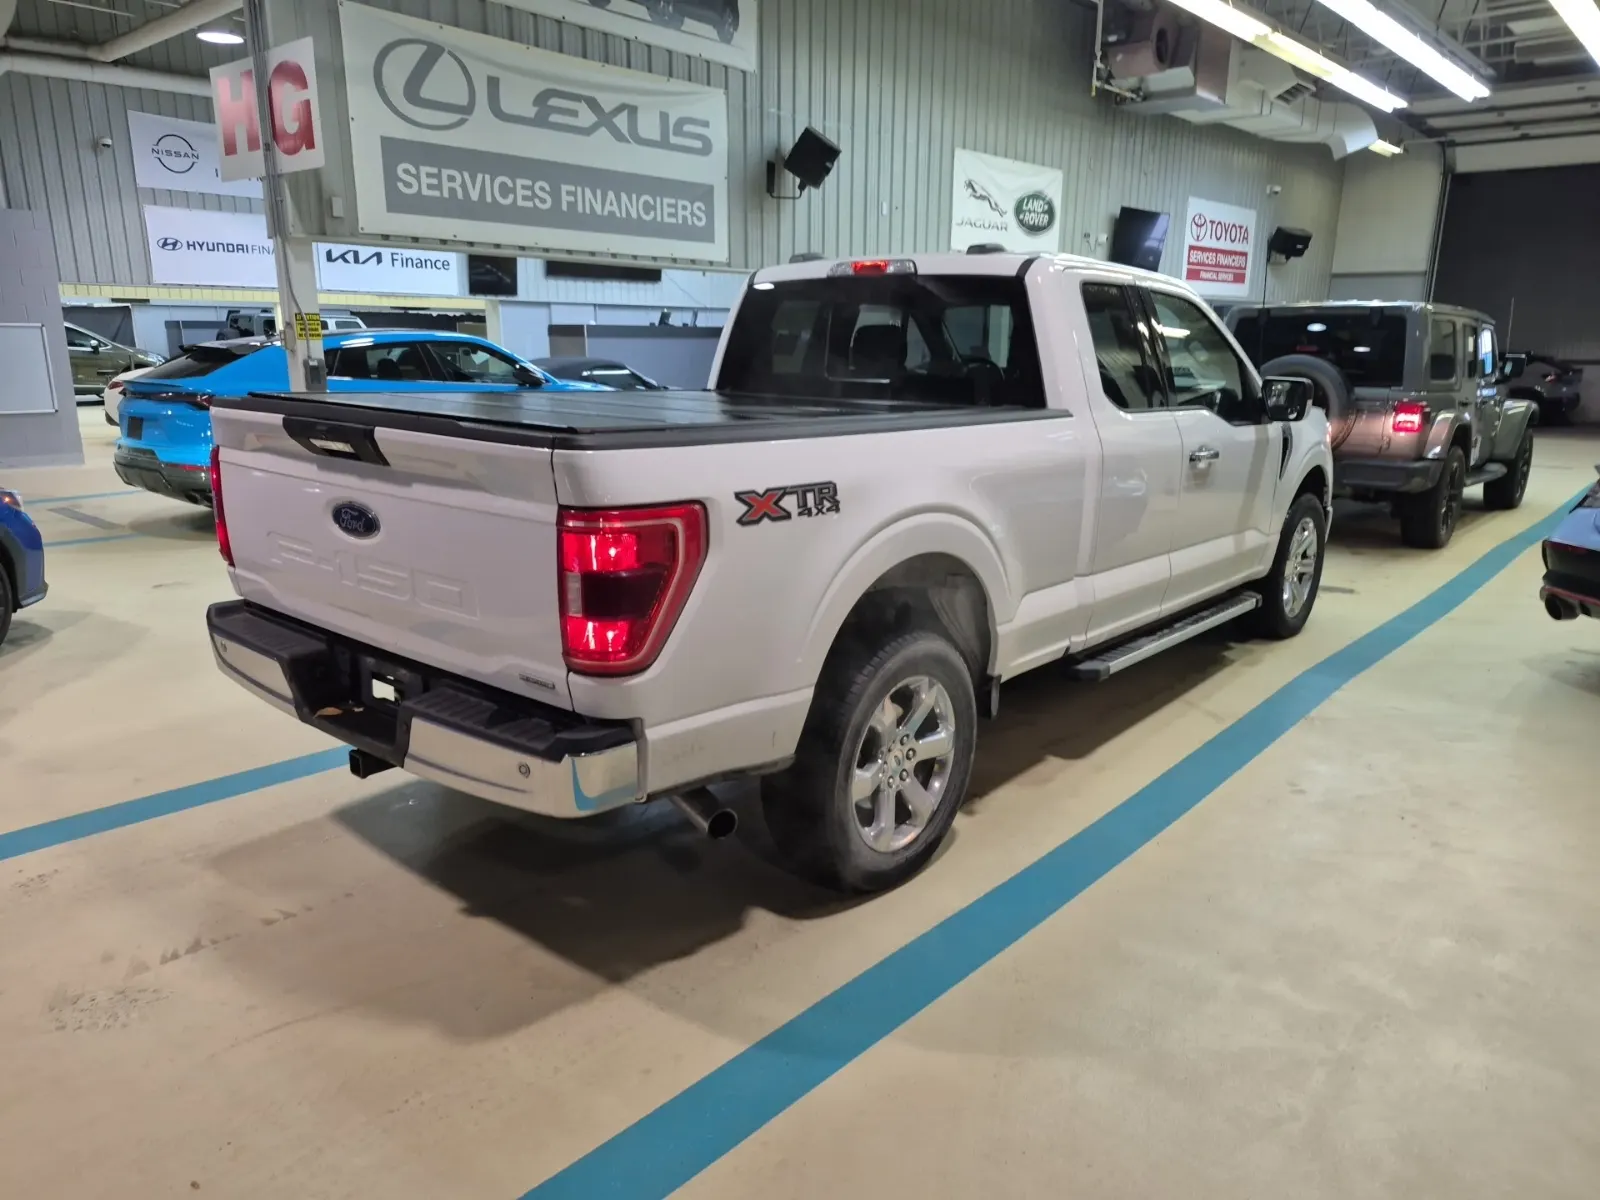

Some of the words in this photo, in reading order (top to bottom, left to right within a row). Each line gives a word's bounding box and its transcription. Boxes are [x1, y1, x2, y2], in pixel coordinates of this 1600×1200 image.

[216, 60, 316, 156] HG
[486, 75, 713, 156] LEXUS
[151, 147, 200, 160] NISSAN
[396, 163, 552, 211] SERVICES
[561, 184, 707, 228] FINANCIERS
[1022, 197, 1044, 212] LAND
[955, 217, 1008, 232] JAGUAR
[1023, 212, 1049, 227] ROVER
[1209, 219, 1249, 245] TOYOTA
[186, 240, 249, 254] HYUNDAI
[325, 248, 383, 266] KIA
[390, 251, 450, 270] Finance
[1189, 249, 1217, 265] SERVICES
[1216, 252, 1246, 268] FINANCIERS
[734, 481, 839, 527] XTR
[339, 507, 366, 533] Ford
[267, 530, 480, 621] F-150
